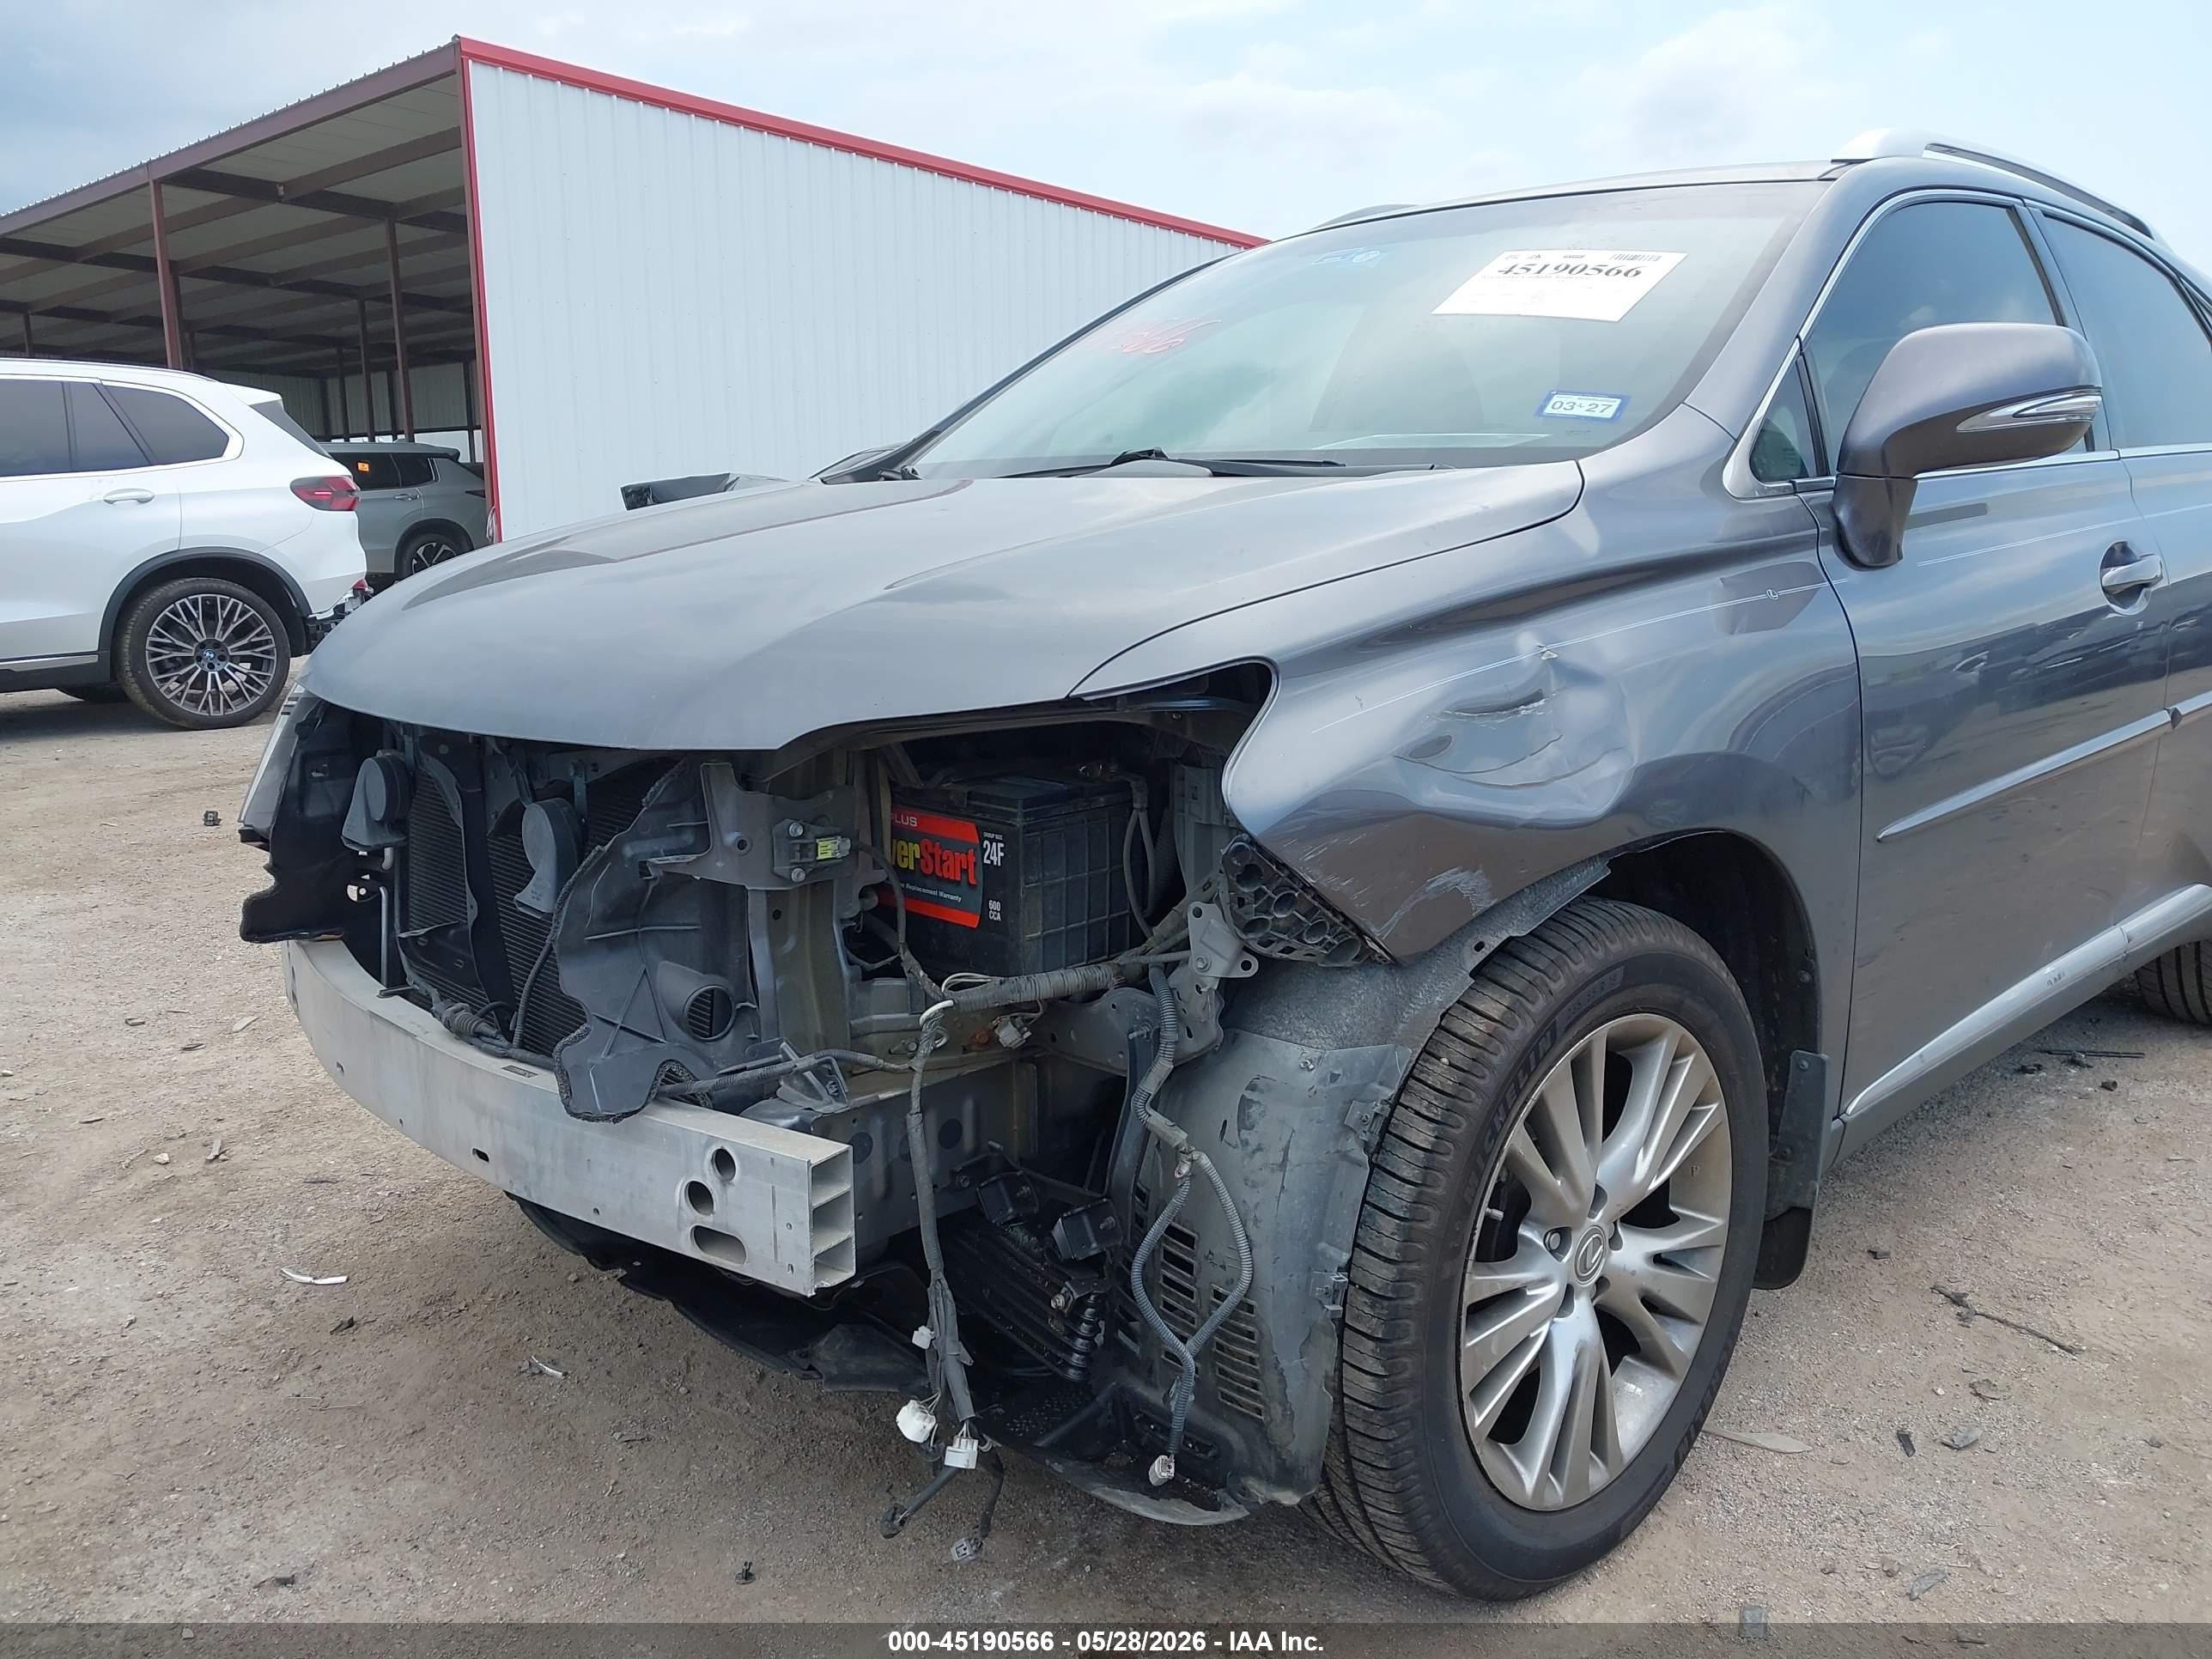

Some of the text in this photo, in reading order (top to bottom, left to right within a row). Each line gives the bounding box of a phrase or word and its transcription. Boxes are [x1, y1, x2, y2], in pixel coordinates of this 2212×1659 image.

[1497, 263, 1647, 277] 45190566
[1551, 400, 1613, 413] 03 27
[983, 840, 1005, 866] 24F
[988, 899, 1001, 911] 600
[988, 910, 1001, 921] CCA
[1462, 1018, 1559, 1208] MICHELIN
